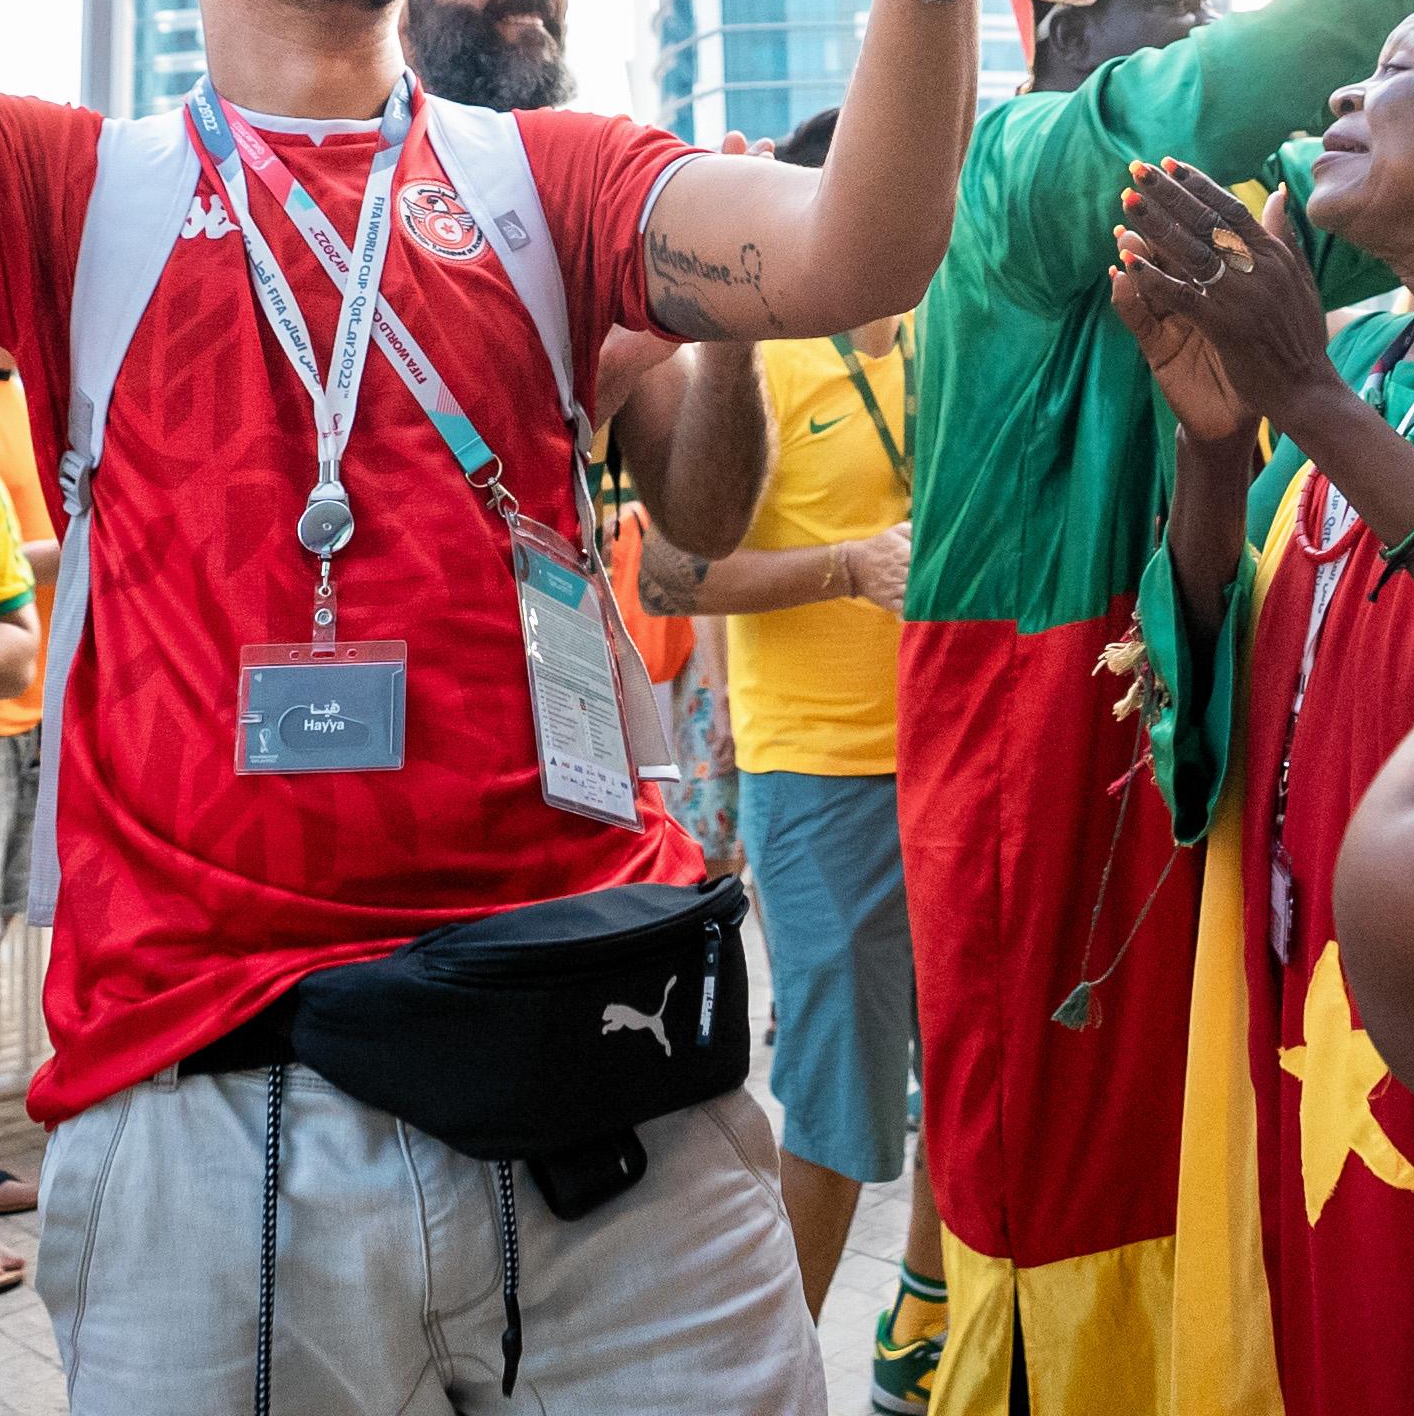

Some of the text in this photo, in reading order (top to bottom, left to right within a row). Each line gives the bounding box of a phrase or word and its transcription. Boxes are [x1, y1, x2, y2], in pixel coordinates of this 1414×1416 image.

[372, 196, 385, 219] FIFA
[361, 220, 378, 263] WORLD
[356, 264, 371, 289] CUP
[267, 287, 287, 316] FIFA
[278, 317, 307, 352] العالم
[378, 321, 427, 385] FIFA WORLD
